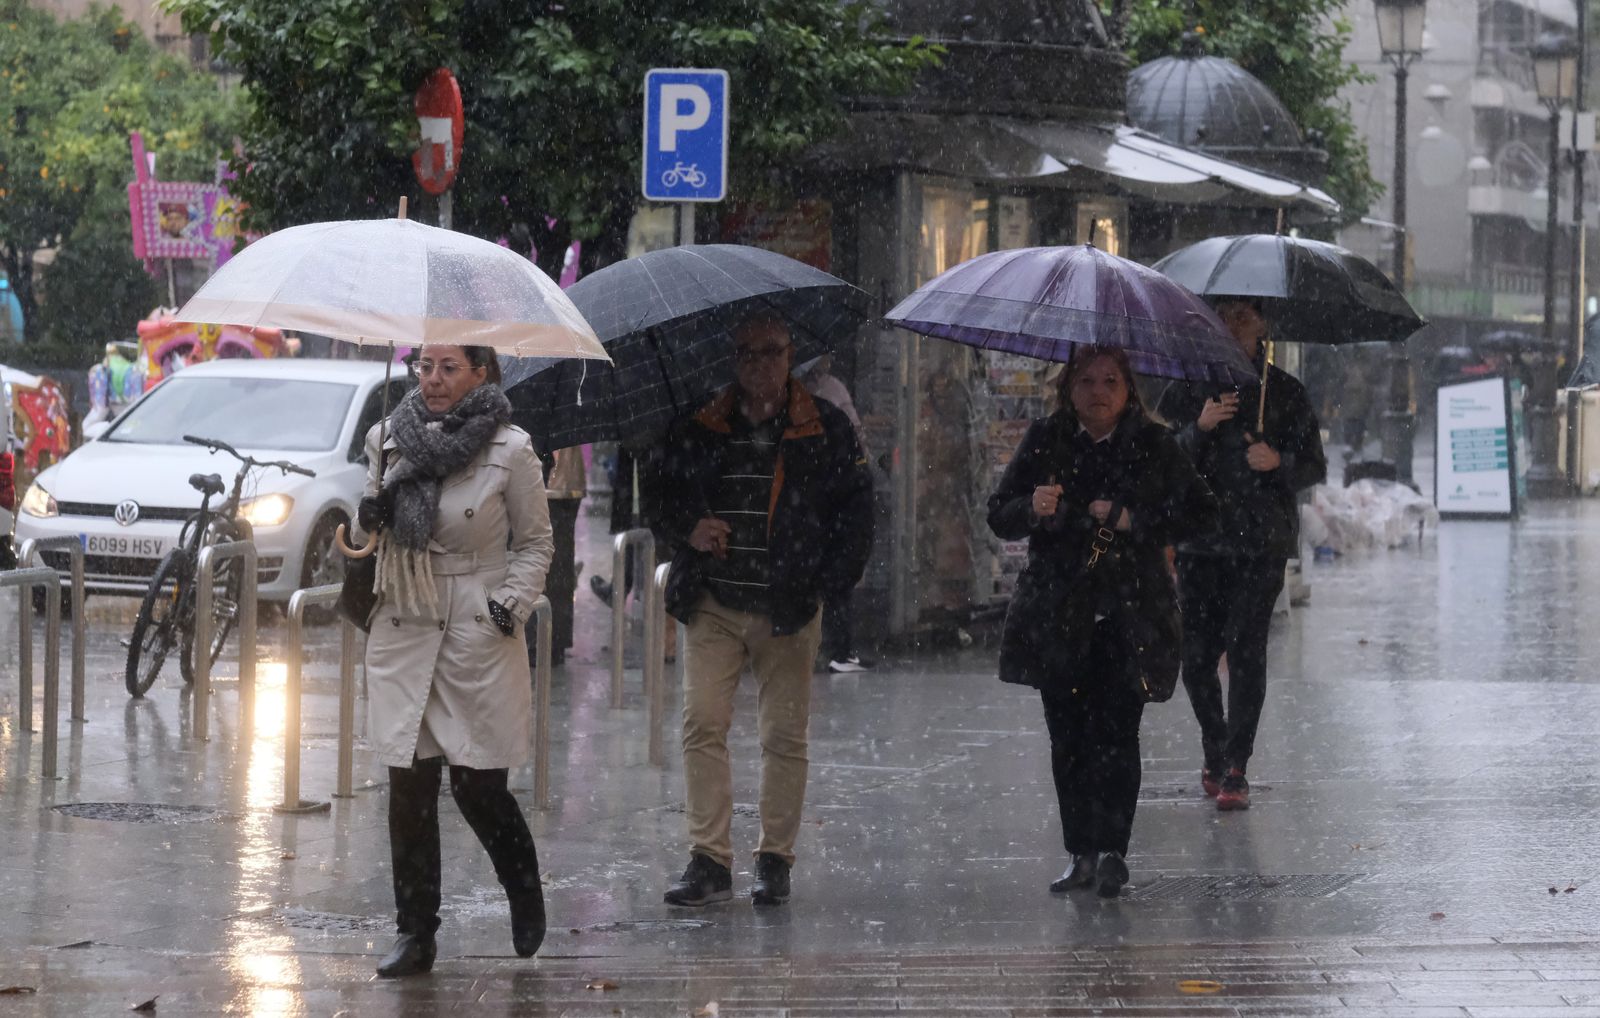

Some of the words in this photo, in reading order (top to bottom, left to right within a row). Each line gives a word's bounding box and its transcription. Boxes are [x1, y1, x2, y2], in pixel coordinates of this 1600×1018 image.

[659, 83, 711, 152] P
[89, 536, 127, 553] 6099
[132, 539, 162, 555] HSV
